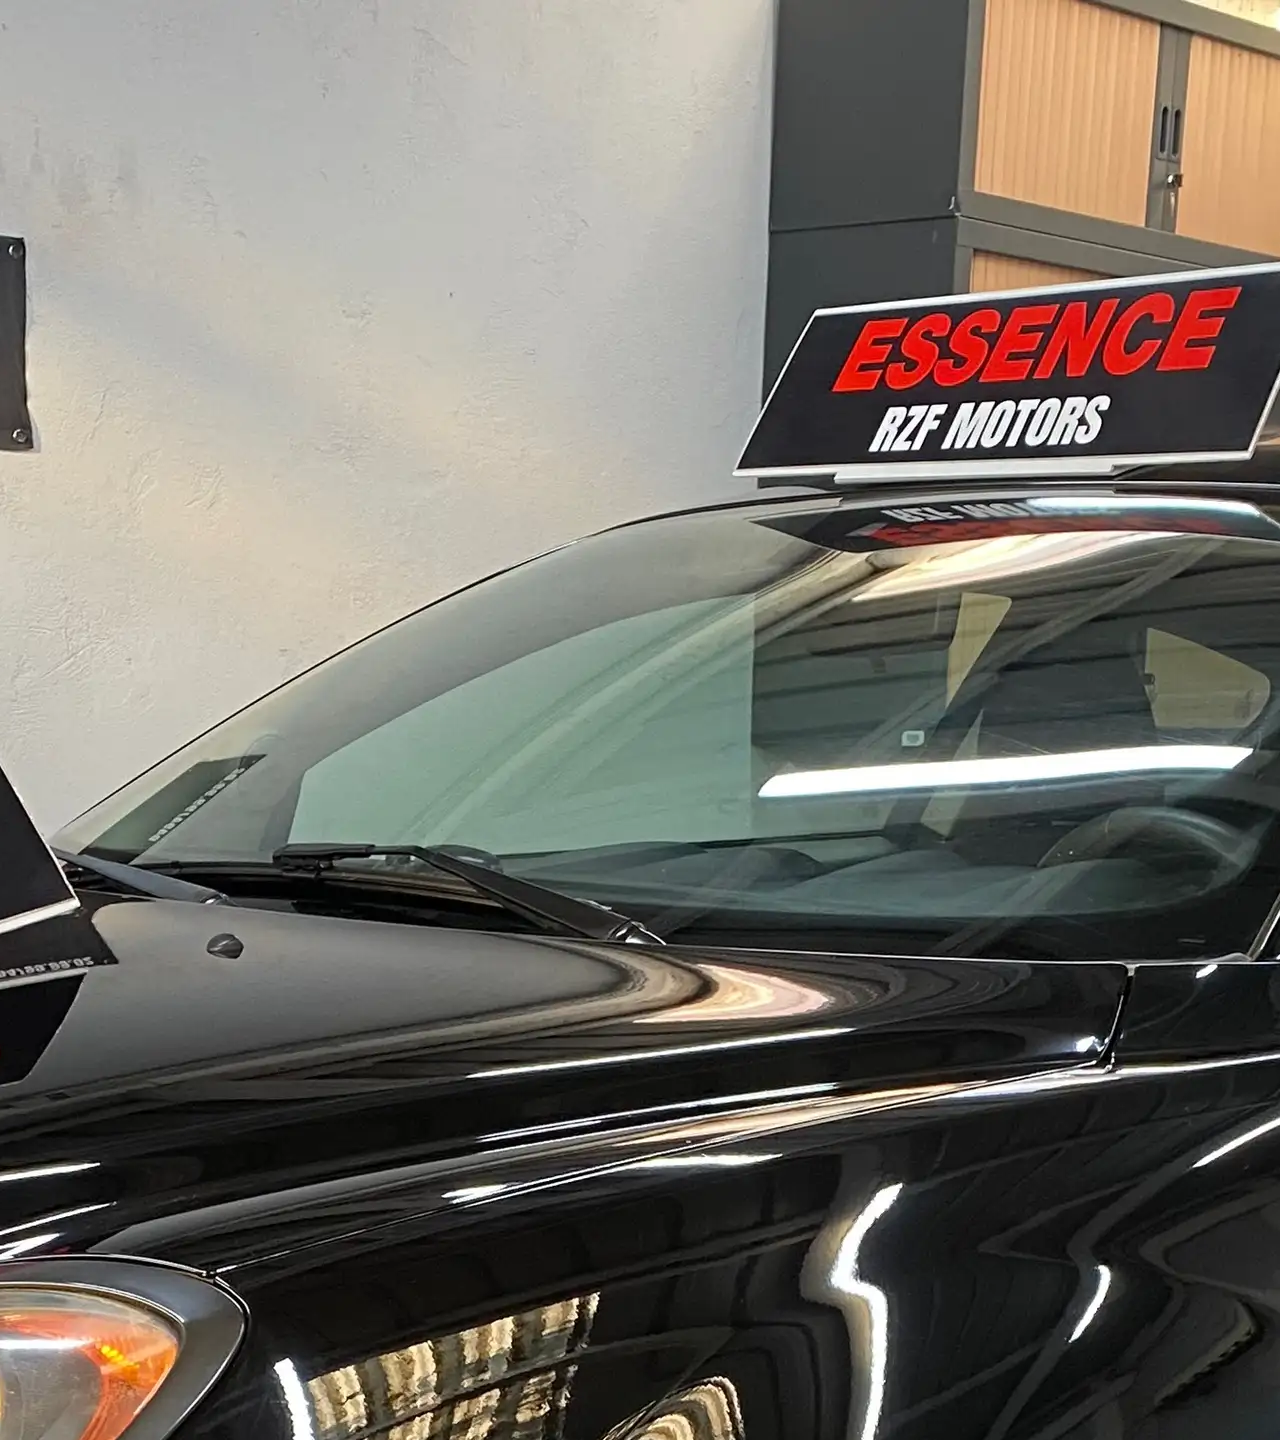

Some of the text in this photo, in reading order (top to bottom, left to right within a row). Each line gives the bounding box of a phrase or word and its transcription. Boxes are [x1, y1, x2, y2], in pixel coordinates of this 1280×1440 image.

[831, 285, 1242, 393] ESSENCE
[868, 395, 1111, 453] RZF MOTORS
